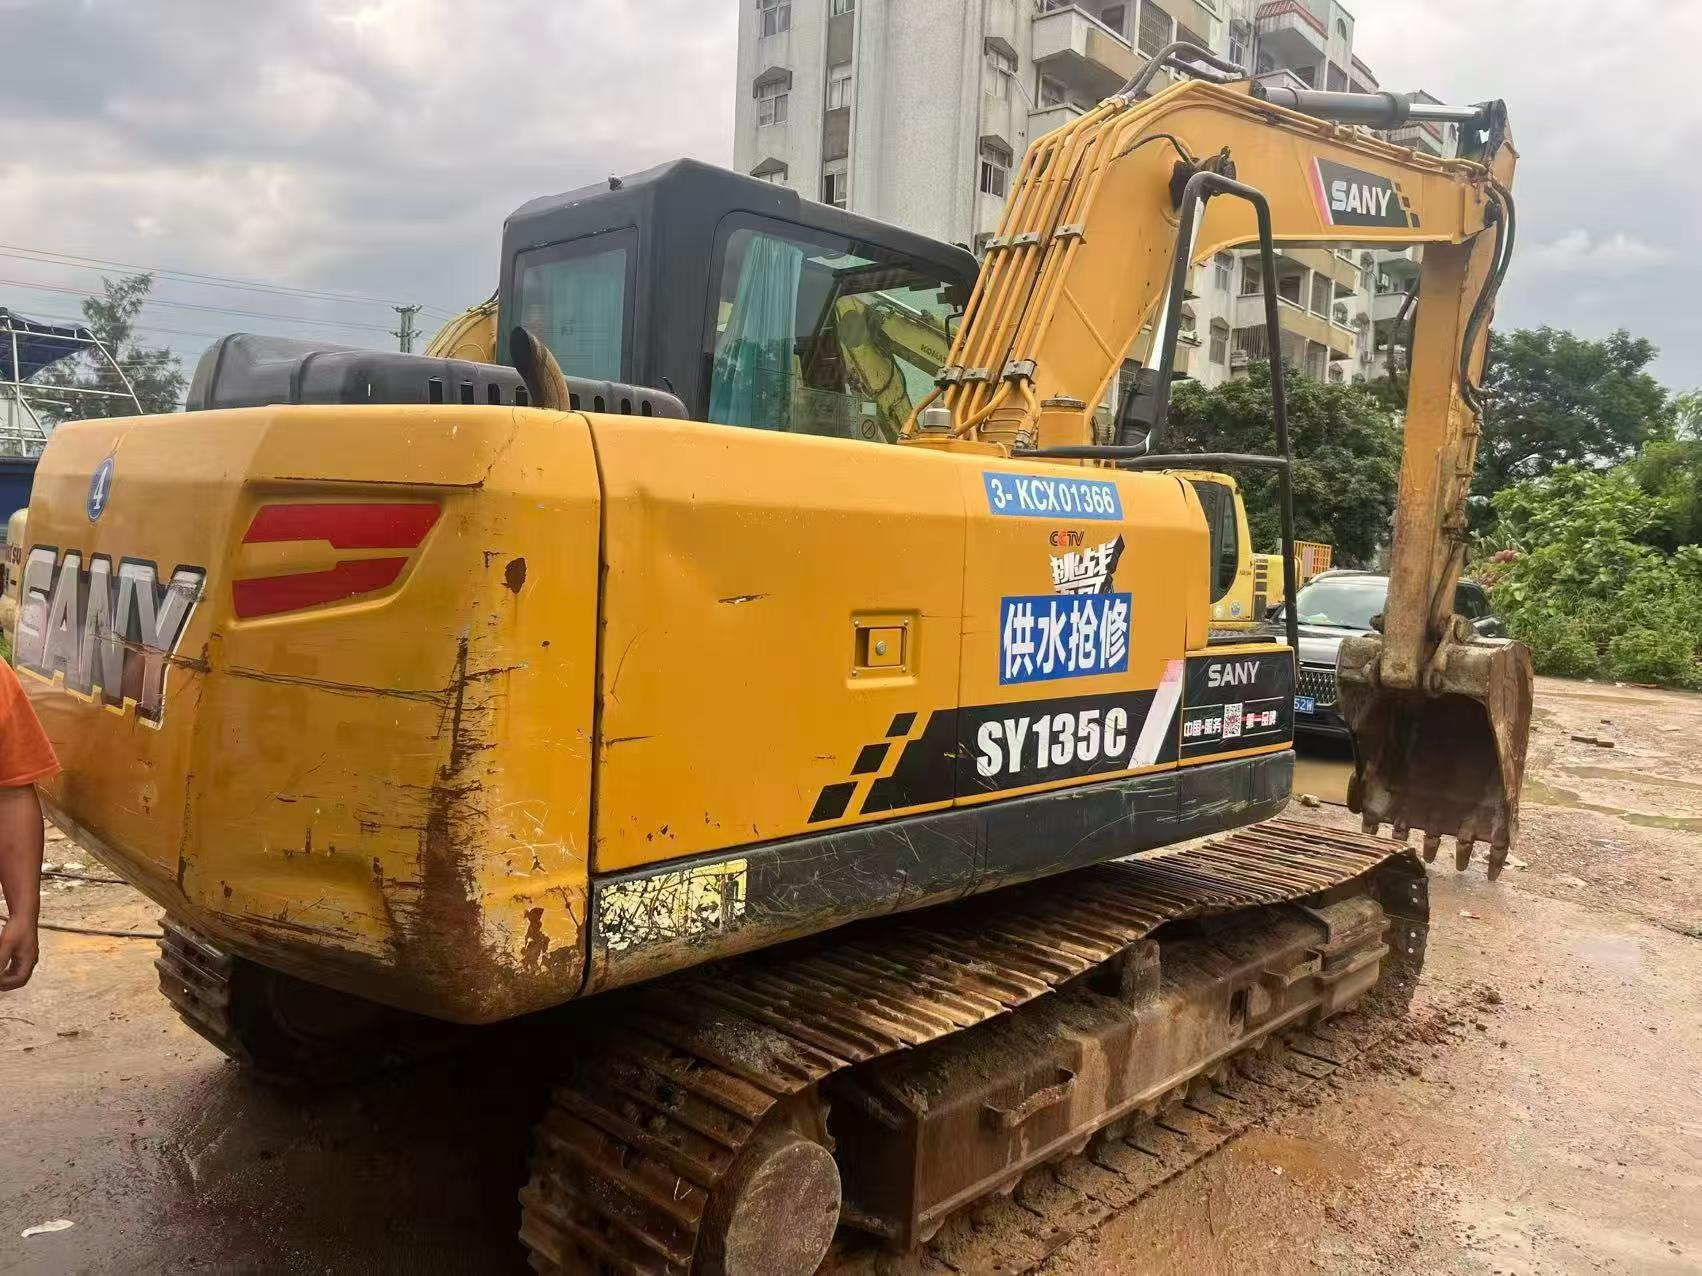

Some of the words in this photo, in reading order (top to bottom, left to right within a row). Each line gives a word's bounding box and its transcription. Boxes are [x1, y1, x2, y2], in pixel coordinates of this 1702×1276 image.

[1331, 180, 1391, 217] SANY
[92, 467, 109, 510] 4
[1019, 479, 1116, 515] KCX01366
[1049, 530, 1085, 547] CCTV
[1049, 535, 1121, 585] 挑战
[15, 546, 207, 722] SANY
[1003, 598, 1128, 680] 供水抢修
[1207, 661, 1260, 688] SANY
[976, 707, 1128, 777] SY135C
